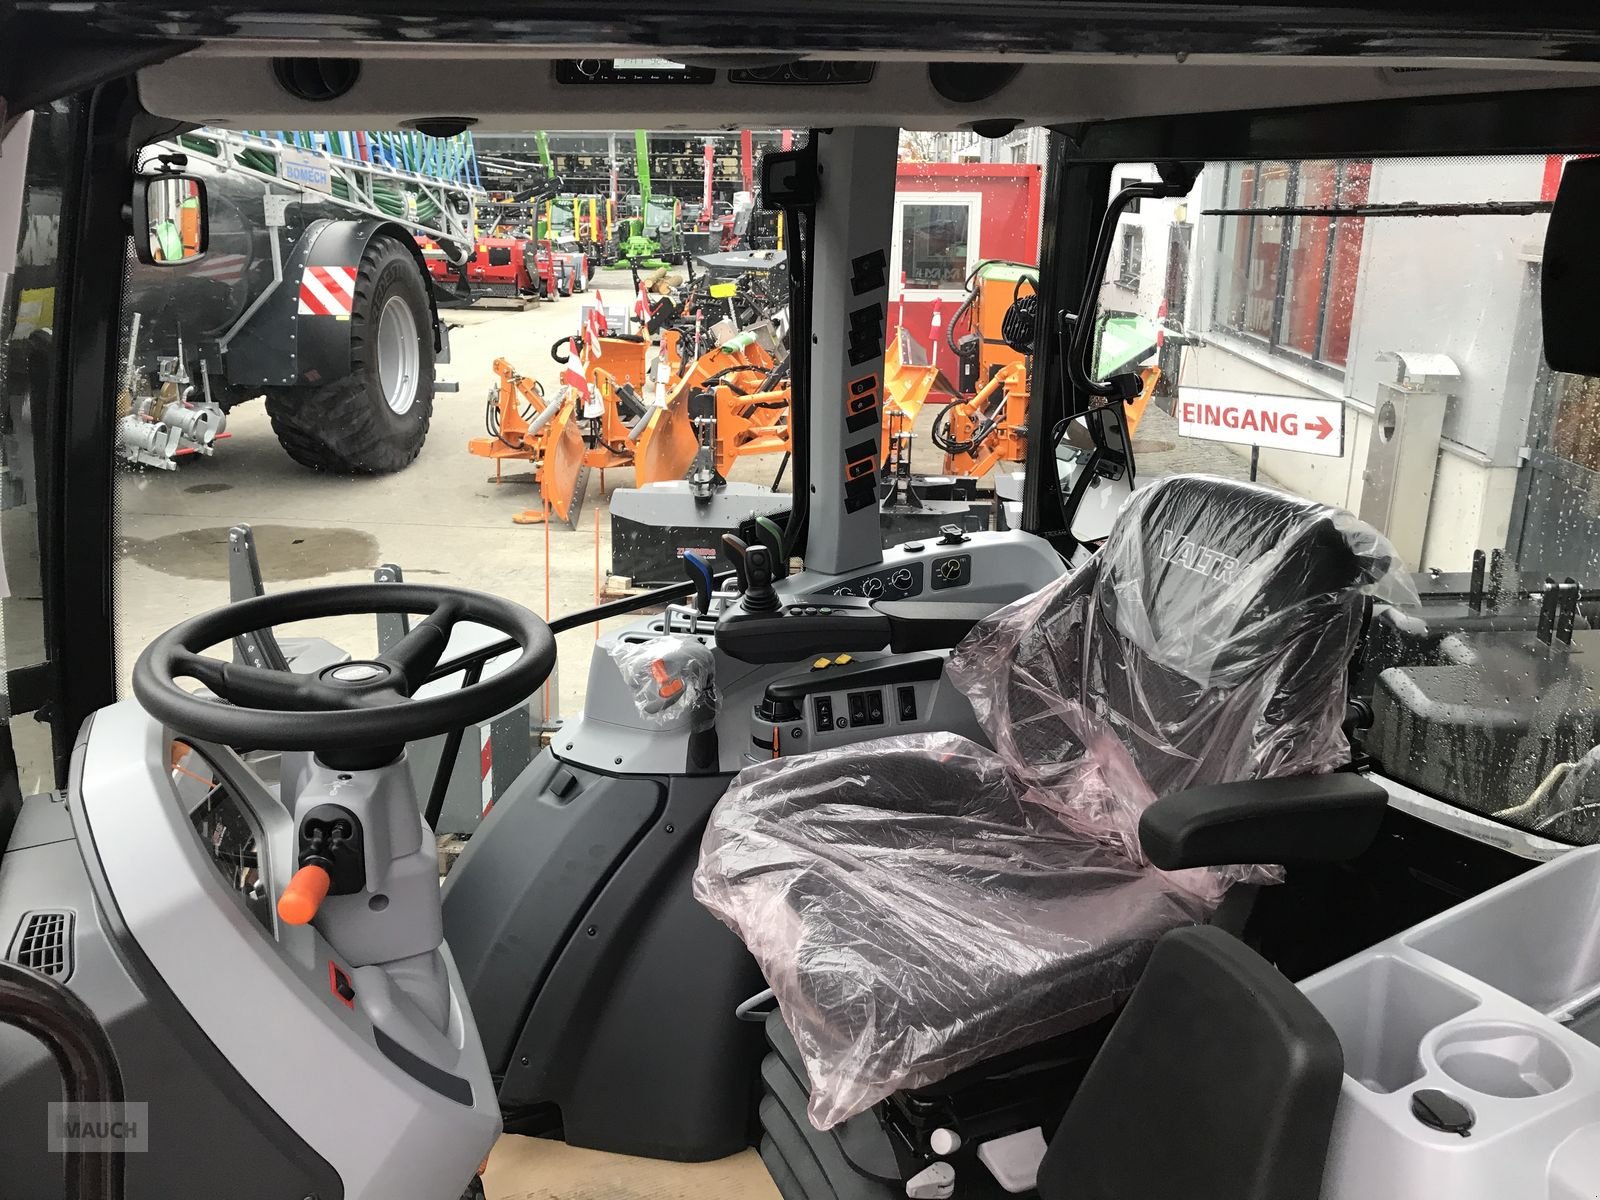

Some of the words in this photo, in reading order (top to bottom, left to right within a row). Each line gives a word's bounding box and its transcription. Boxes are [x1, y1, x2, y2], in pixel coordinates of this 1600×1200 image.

[286, 166, 327, 185] BOMECH
[1183, 402, 1298, 436] EINGANG
[1160, 529, 1250, 586] VALTR
